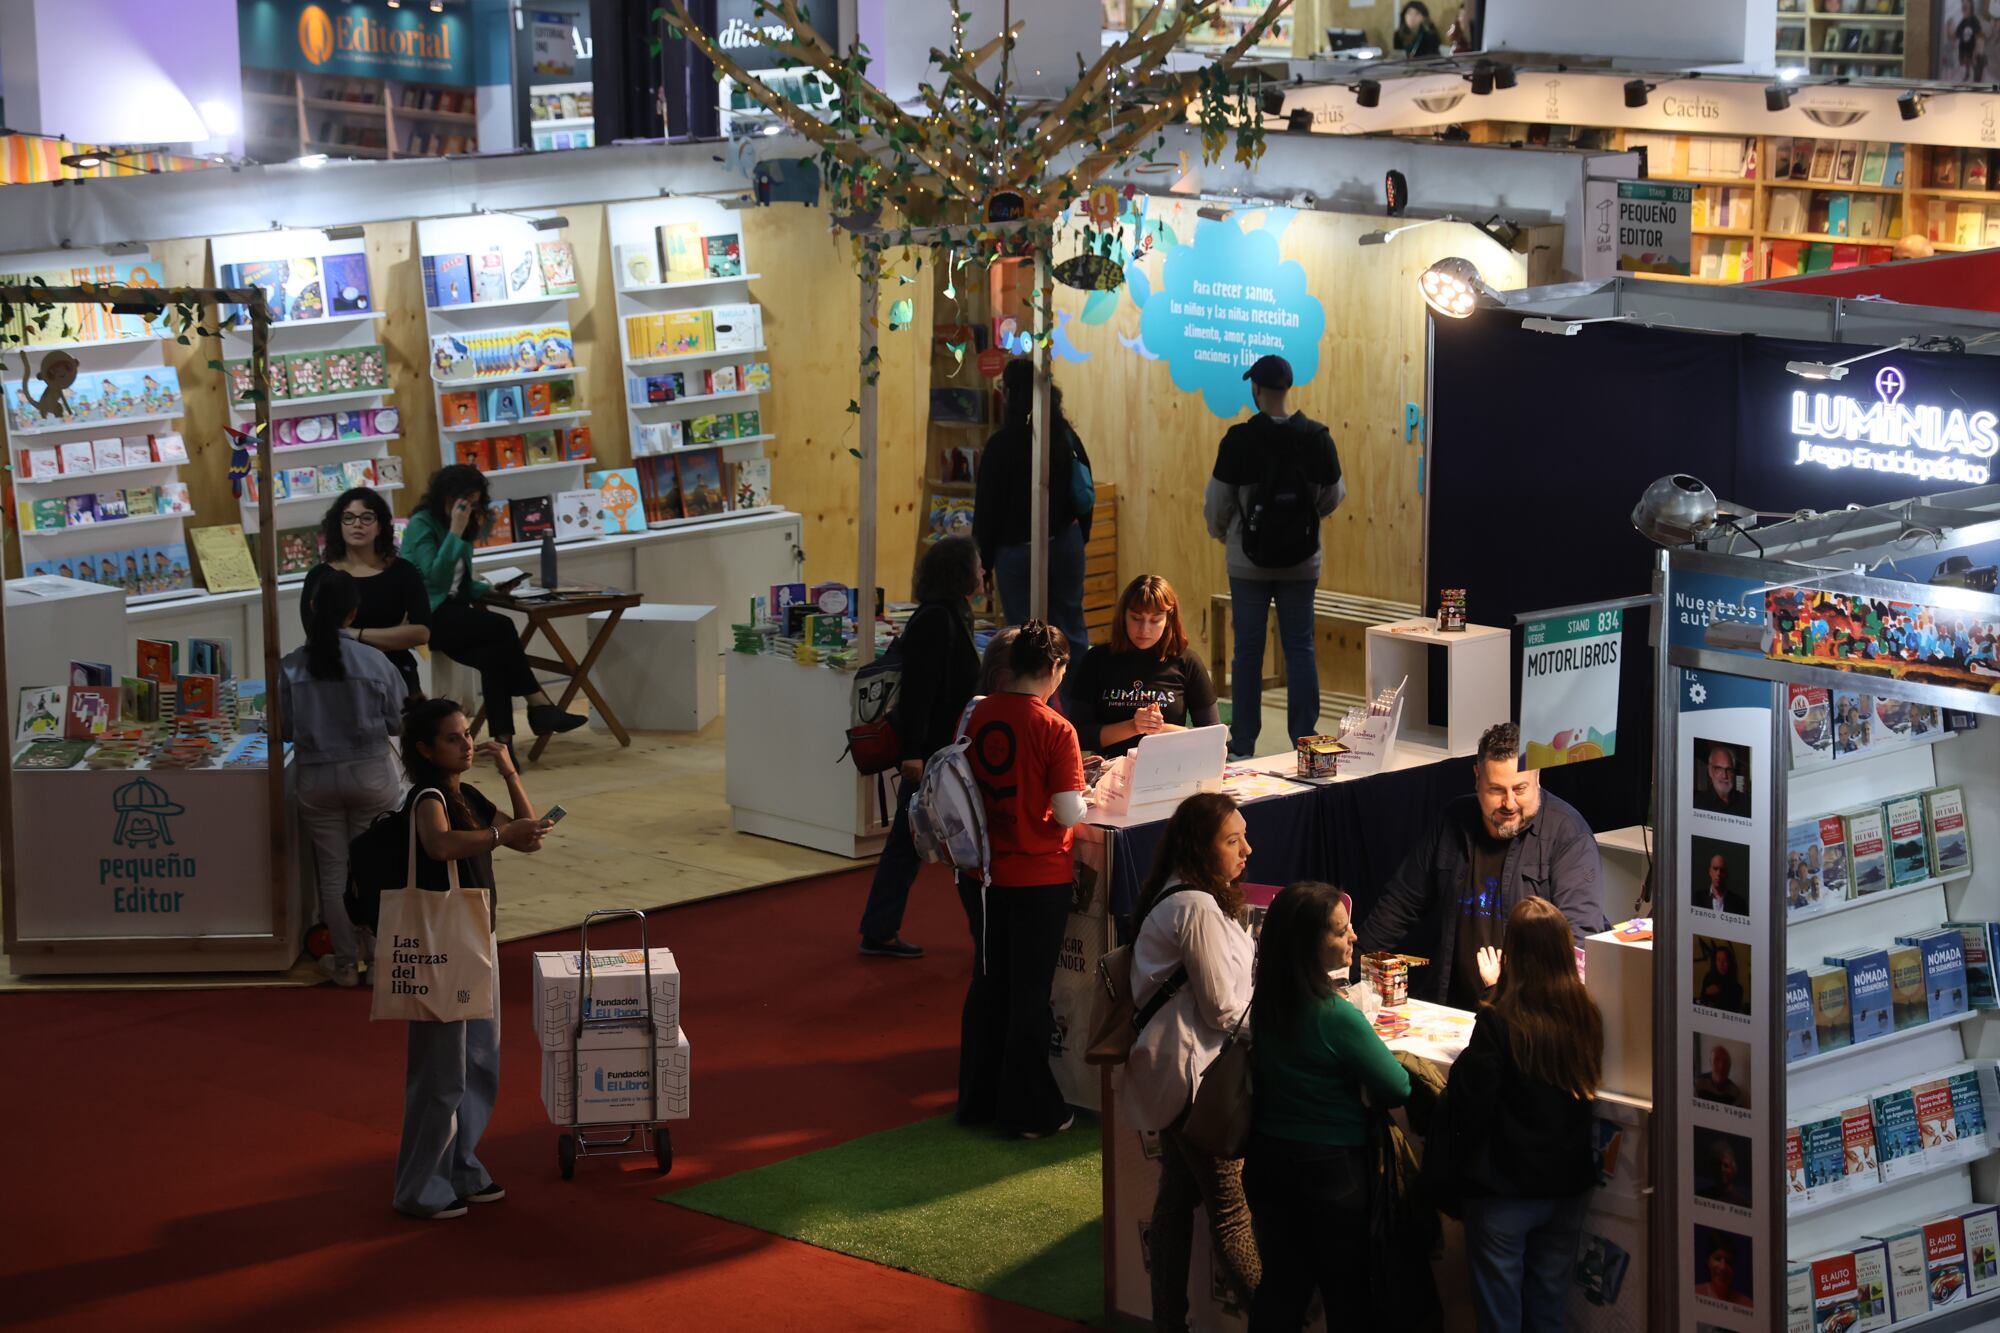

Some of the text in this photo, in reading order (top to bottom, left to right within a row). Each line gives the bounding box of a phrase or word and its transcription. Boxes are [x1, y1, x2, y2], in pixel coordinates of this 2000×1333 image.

[336, 15, 451, 60] Editorial
[719, 19, 794, 49] ditores
[1662, 95, 1720, 120] Cactus
[1620, 202, 1677, 224] PEQUEÑO
[1620, 227, 1663, 247] EDITOR
[1193, 280, 1277, 304] Para crecer sanos,
[1184, 301, 1205, 317] niños
[1207, 306, 1213, 320] y
[1228, 306, 1249, 322] niñas
[1251, 308, 1300, 328] necesitan
[1184, 325, 1285, 350] alimento, amor, palabras,
[1194, 349, 1231, 364] canciones
[1232, 354, 1238, 367] y
[1791, 391, 1999, 457] LUMINIAS
[1675, 592, 1757, 619] Nuestros
[1567, 619, 1590, 634] STAND
[1598, 610, 1619, 632] 834
[1527, 633, 1545, 644] VERDE
[1527, 640, 1618, 678] MOTORLIBROS
[1102, 688, 1176, 703] LUMINIAS
[100, 853, 196, 885] pequeño
[114, 886, 184, 913] Editor
[1690, 908, 1750, 926] Franco Cipolla
[393, 935, 420, 948] Las
[393, 950, 448, 965] fuerzas
[1928, 948, 1962, 966] NÓMADA
[391, 966, 415, 979] del
[1929, 960, 1962, 974] EN SUDAMÉRICA
[1854, 968, 1888, 987] NÓMADA
[391, 981, 429, 995] libro
[1786, 988, 1808, 1002] MADA
[1862, 980, 1889, 994] SUDAMÉRICA
[596, 998, 639, 1006] Fundación
[608, 1070, 650, 1078] Fundación
[608, 1080, 650, 1091] El Libro
[1920, 1098, 1948, 1110] para incluir
[1846, 1124, 1870, 1136] para incluir
[1929, 1234, 1956, 1247] EL AUTO
[1939, 1244, 1957, 1254] pueblo
[1821, 1268, 1850, 1284] EL AUTO
[1822, 1280, 1850, 1292] del pueblo
